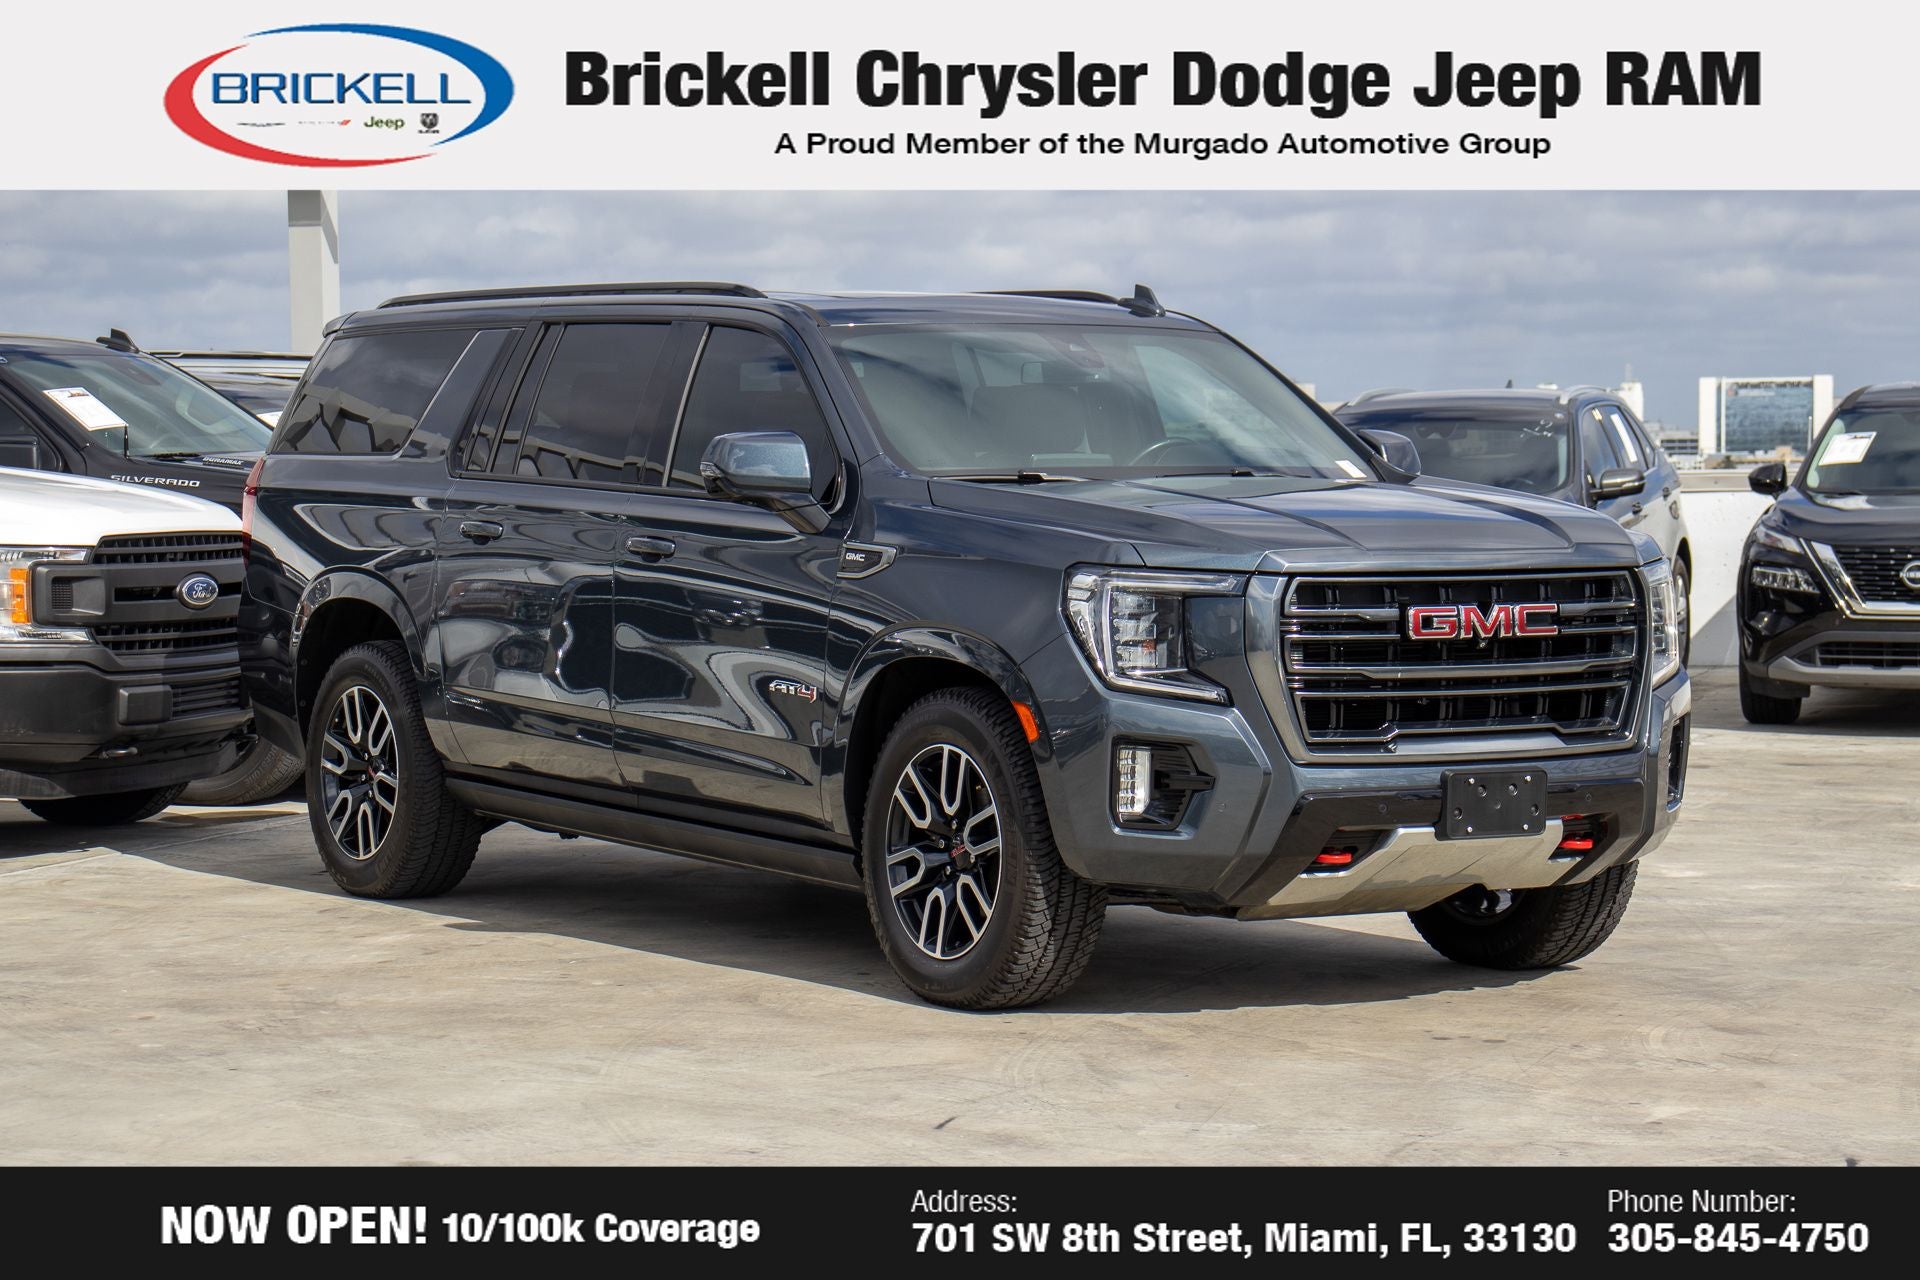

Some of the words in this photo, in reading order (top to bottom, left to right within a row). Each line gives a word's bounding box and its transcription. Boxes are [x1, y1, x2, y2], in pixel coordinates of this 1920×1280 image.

[110, 474, 201, 488] SILVERADO
[845, 552, 866, 562] GMC
[192, 582, 212, 599] Ford
[1407, 603, 1559, 640] GMC
[768, 679, 817, 704] AT4
